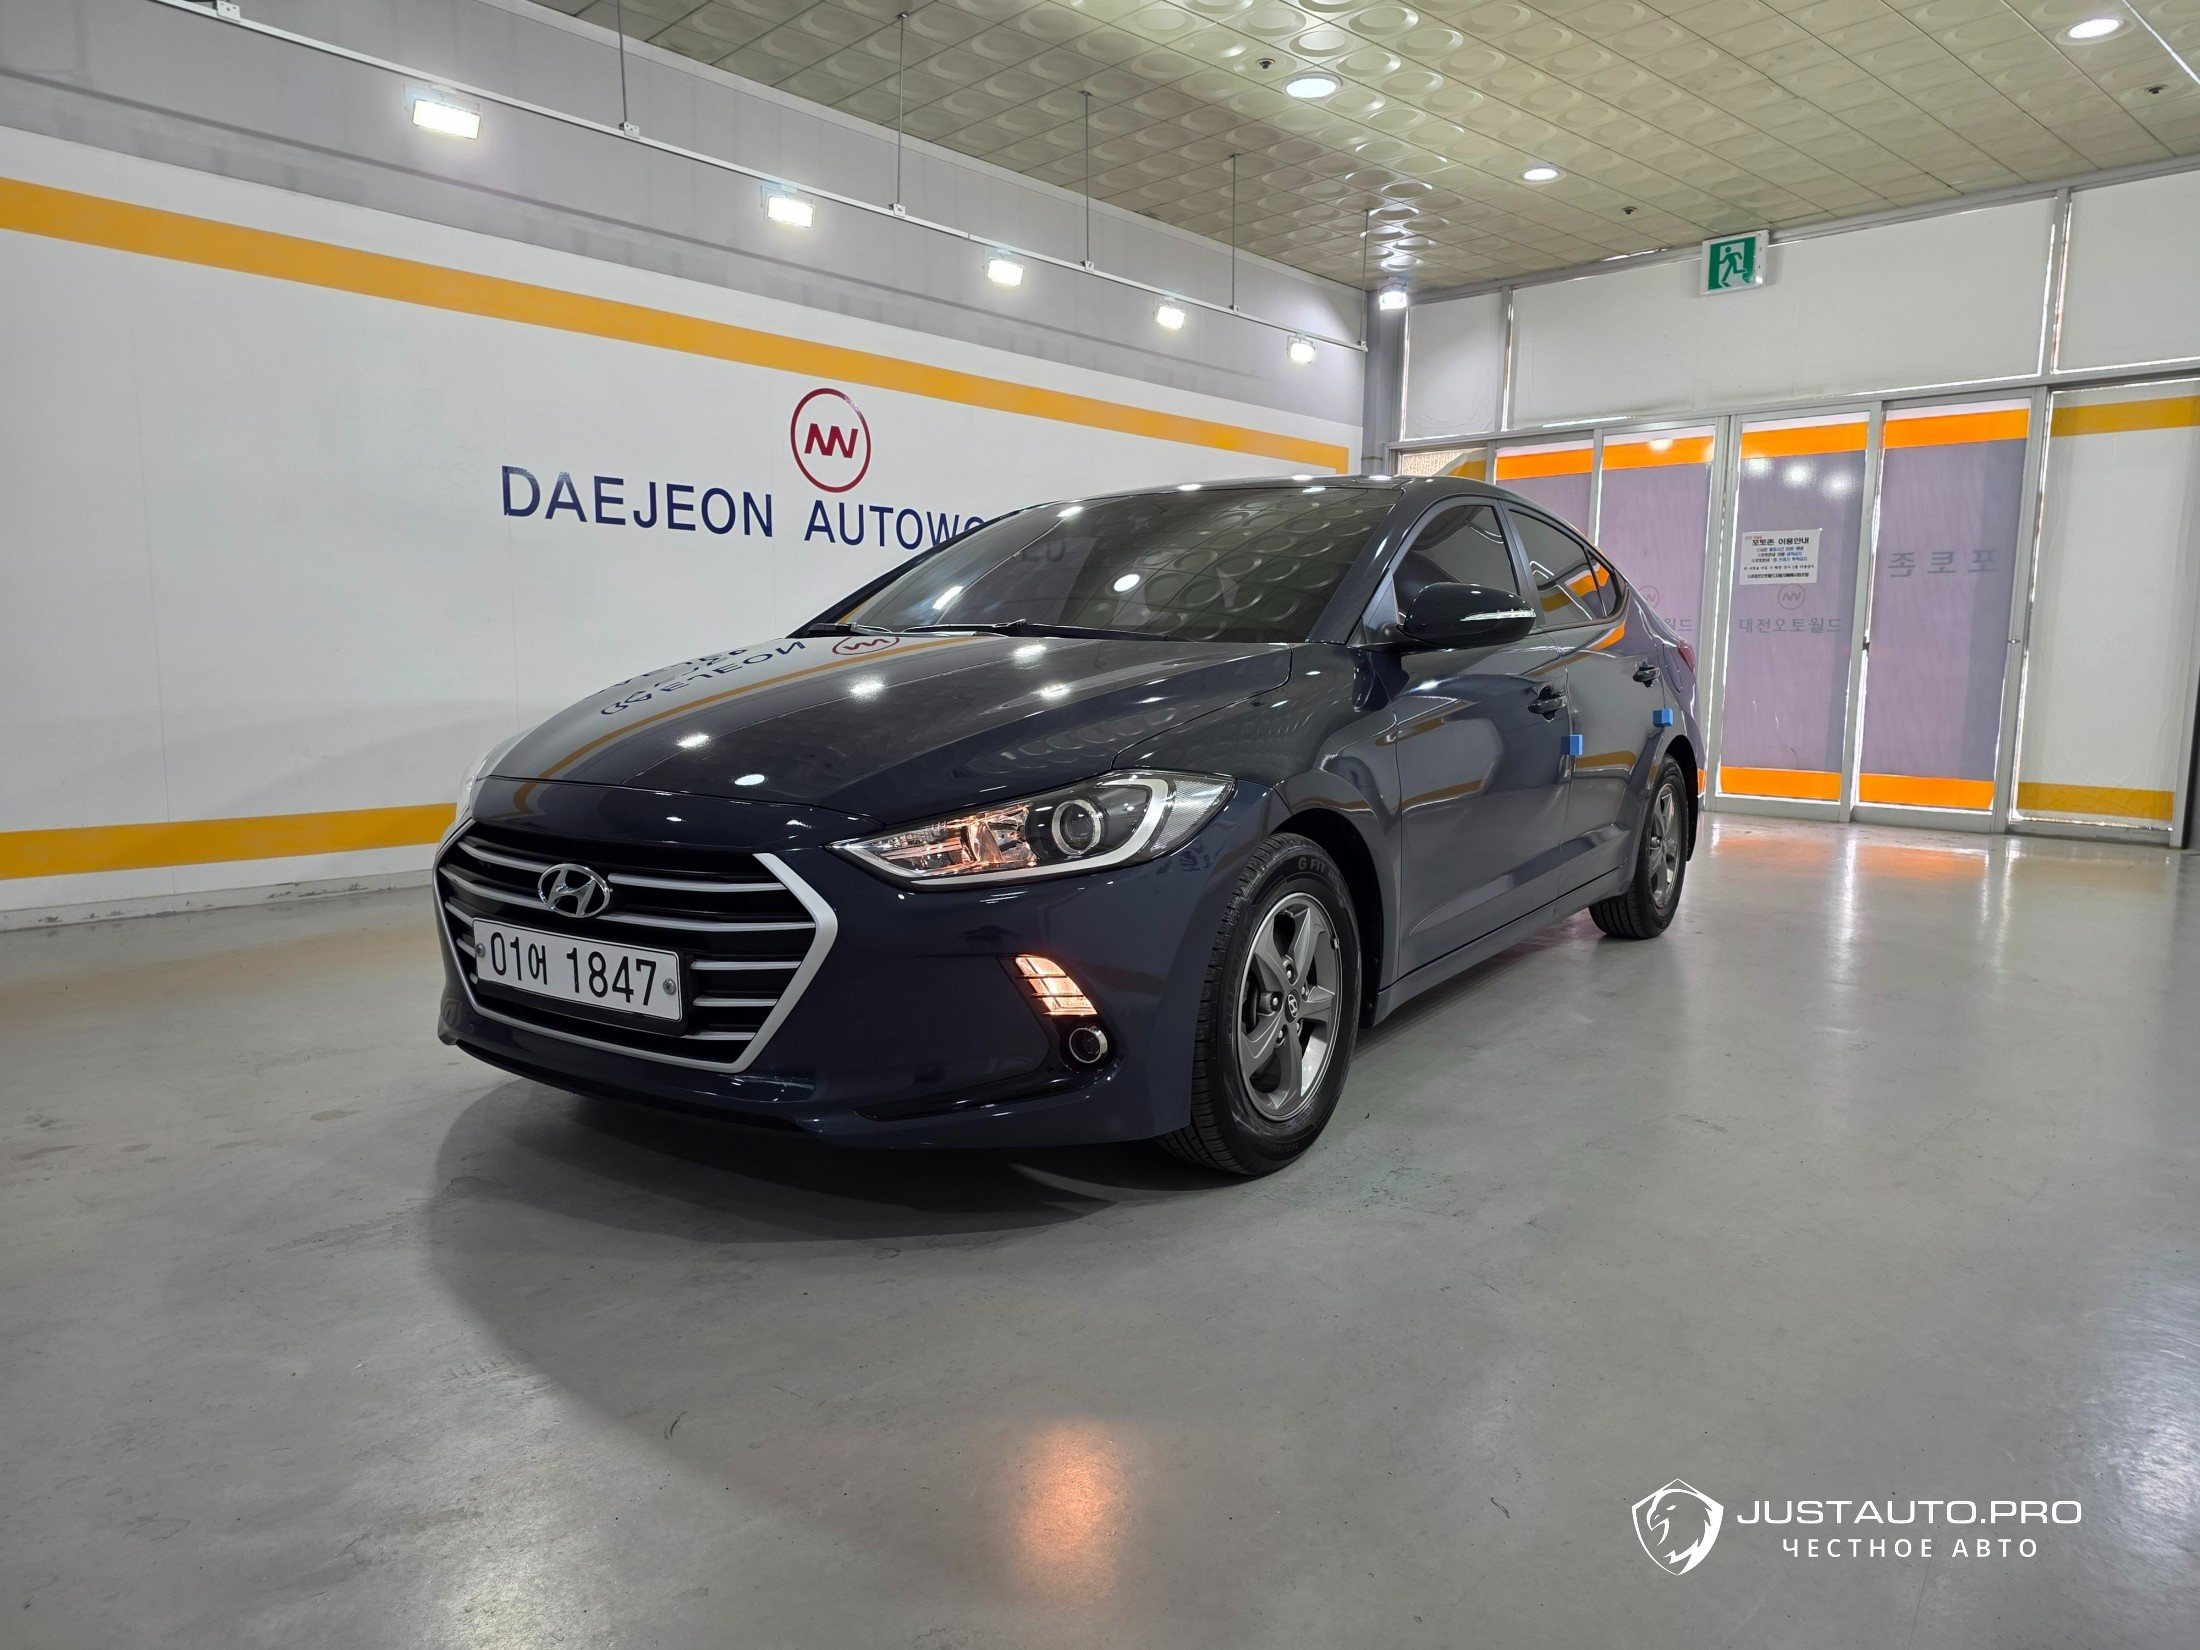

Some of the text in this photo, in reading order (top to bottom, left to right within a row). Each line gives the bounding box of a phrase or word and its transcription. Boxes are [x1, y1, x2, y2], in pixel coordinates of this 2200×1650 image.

[501, 465, 773, 538] DAEJEON
[1739, 617, 1843, 634] 대전오토월드
[1309, 858, 1327, 873] FIT
[490, 931, 657, 1006] 01어 1847
